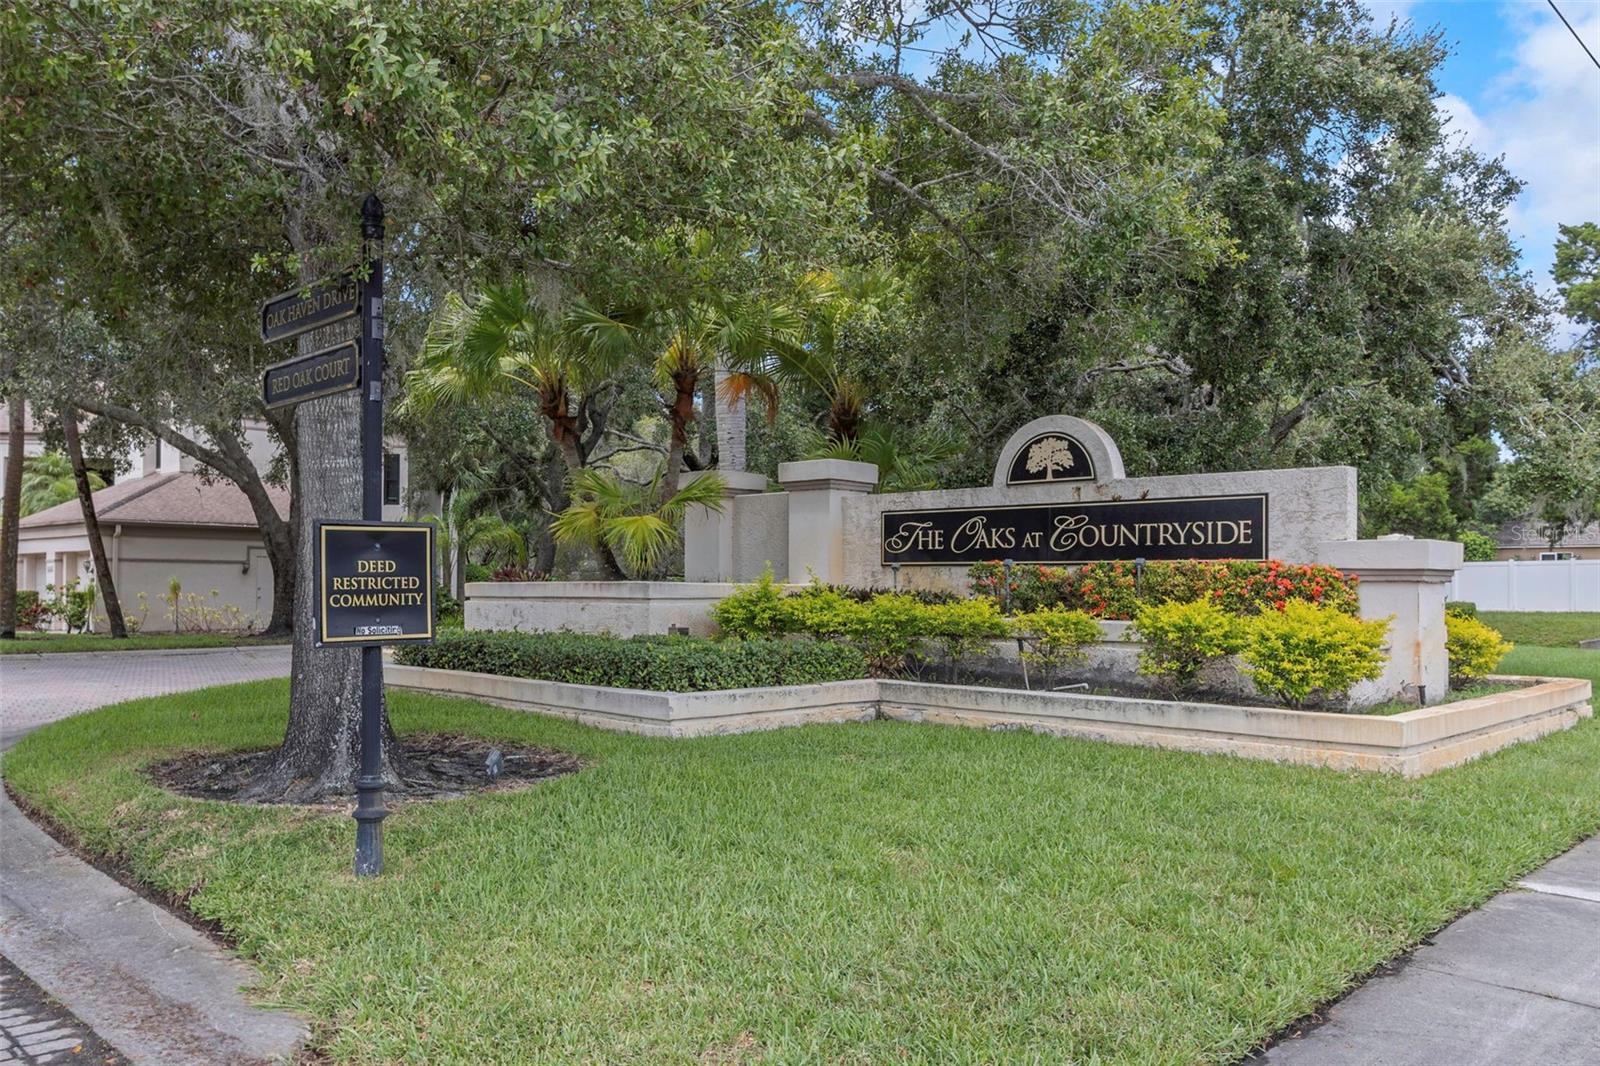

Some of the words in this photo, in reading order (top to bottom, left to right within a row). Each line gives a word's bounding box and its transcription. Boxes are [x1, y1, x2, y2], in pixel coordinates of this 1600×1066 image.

[266, 309, 287, 329] OAK
[288, 296, 320, 322] HAVEN
[323, 284, 355, 309] DRIVE
[272, 375, 291, 395] RED
[292, 367, 316, 389] OAK
[314, 357, 351, 382] COURT
[884, 521, 944, 554] THE
[950, 515, 1016, 554] OAKS
[1021, 531, 1044, 548] AT
[1049, 514, 1253, 552] COUNTRYSIDE
[357, 560, 396, 573] DEED
[332, 576, 420, 590] RESTRICTED
[329, 593, 423, 608] COMMUNITY
